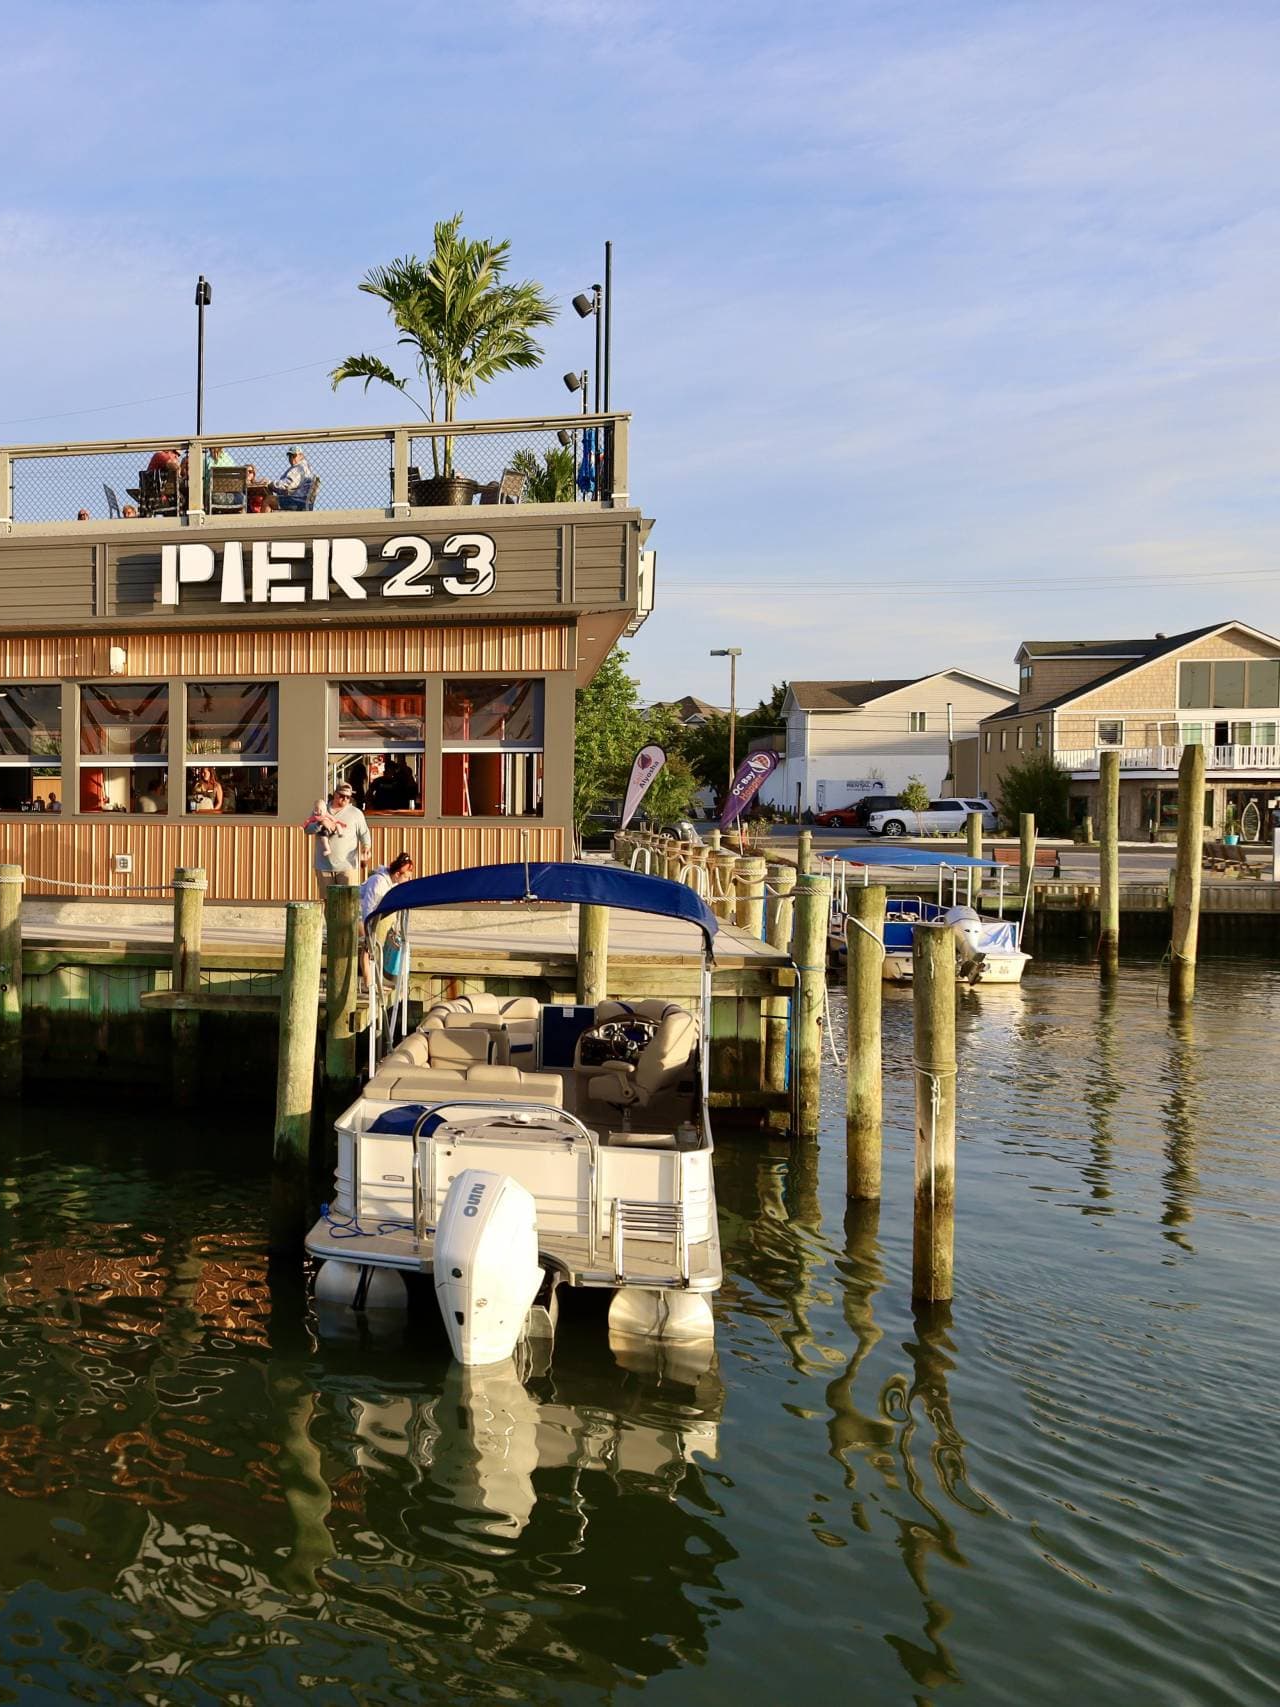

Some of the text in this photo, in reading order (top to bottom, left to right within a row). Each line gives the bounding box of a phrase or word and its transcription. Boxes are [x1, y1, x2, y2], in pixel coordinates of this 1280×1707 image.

[161, 532, 498, 605] PIER 23
[639, 762, 660, 789] Alyosha
[732, 771, 756, 796] OC Bay
[738, 774, 762, 801] Hopper
[463, 1183, 486, 1217] 250
